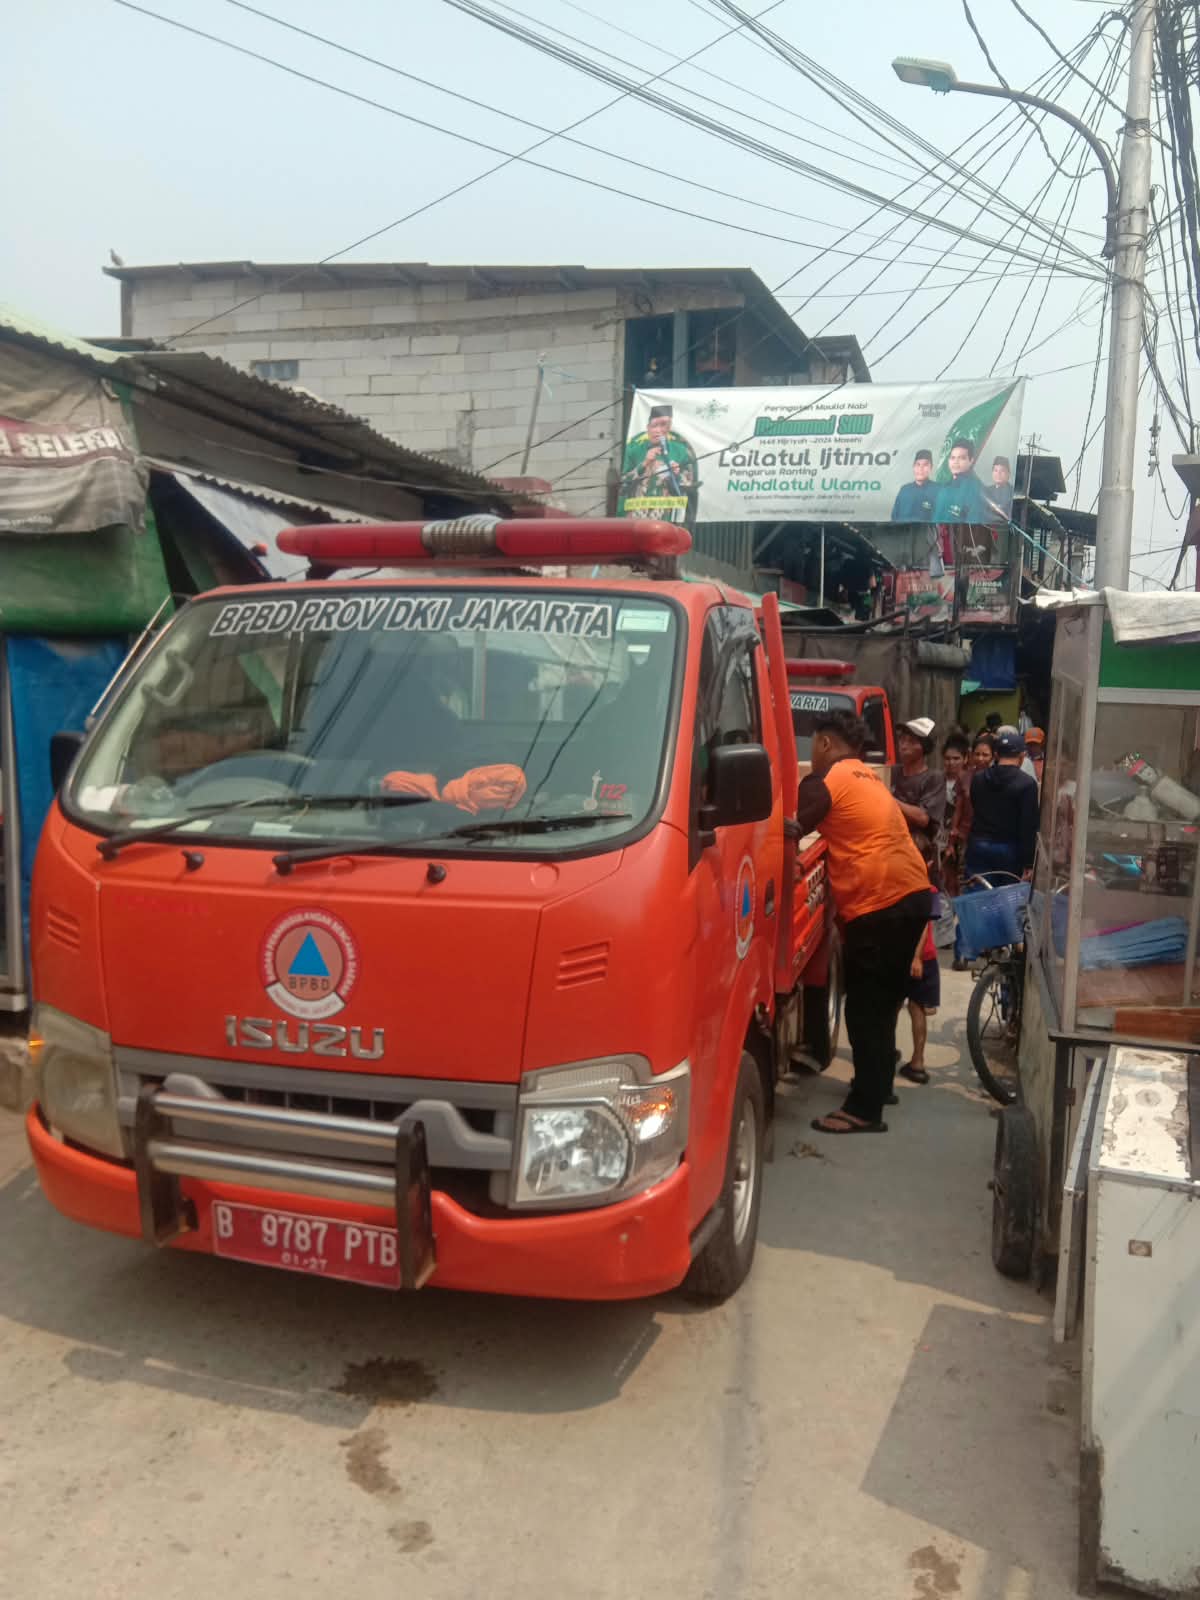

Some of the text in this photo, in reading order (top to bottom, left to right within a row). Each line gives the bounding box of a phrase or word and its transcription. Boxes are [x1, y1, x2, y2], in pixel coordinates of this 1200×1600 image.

[718, 449, 811, 468] Lailatul
[729, 467, 818, 478] Pengurus Ranting
[727, 478, 882, 492] Nahdlatul Ulama
[209, 597, 613, 639] BPBD PROV DKI JAKARTA
[225, 1015, 385, 1060] ISUZU
[216, 1205, 398, 1267] B 9787 PTB
